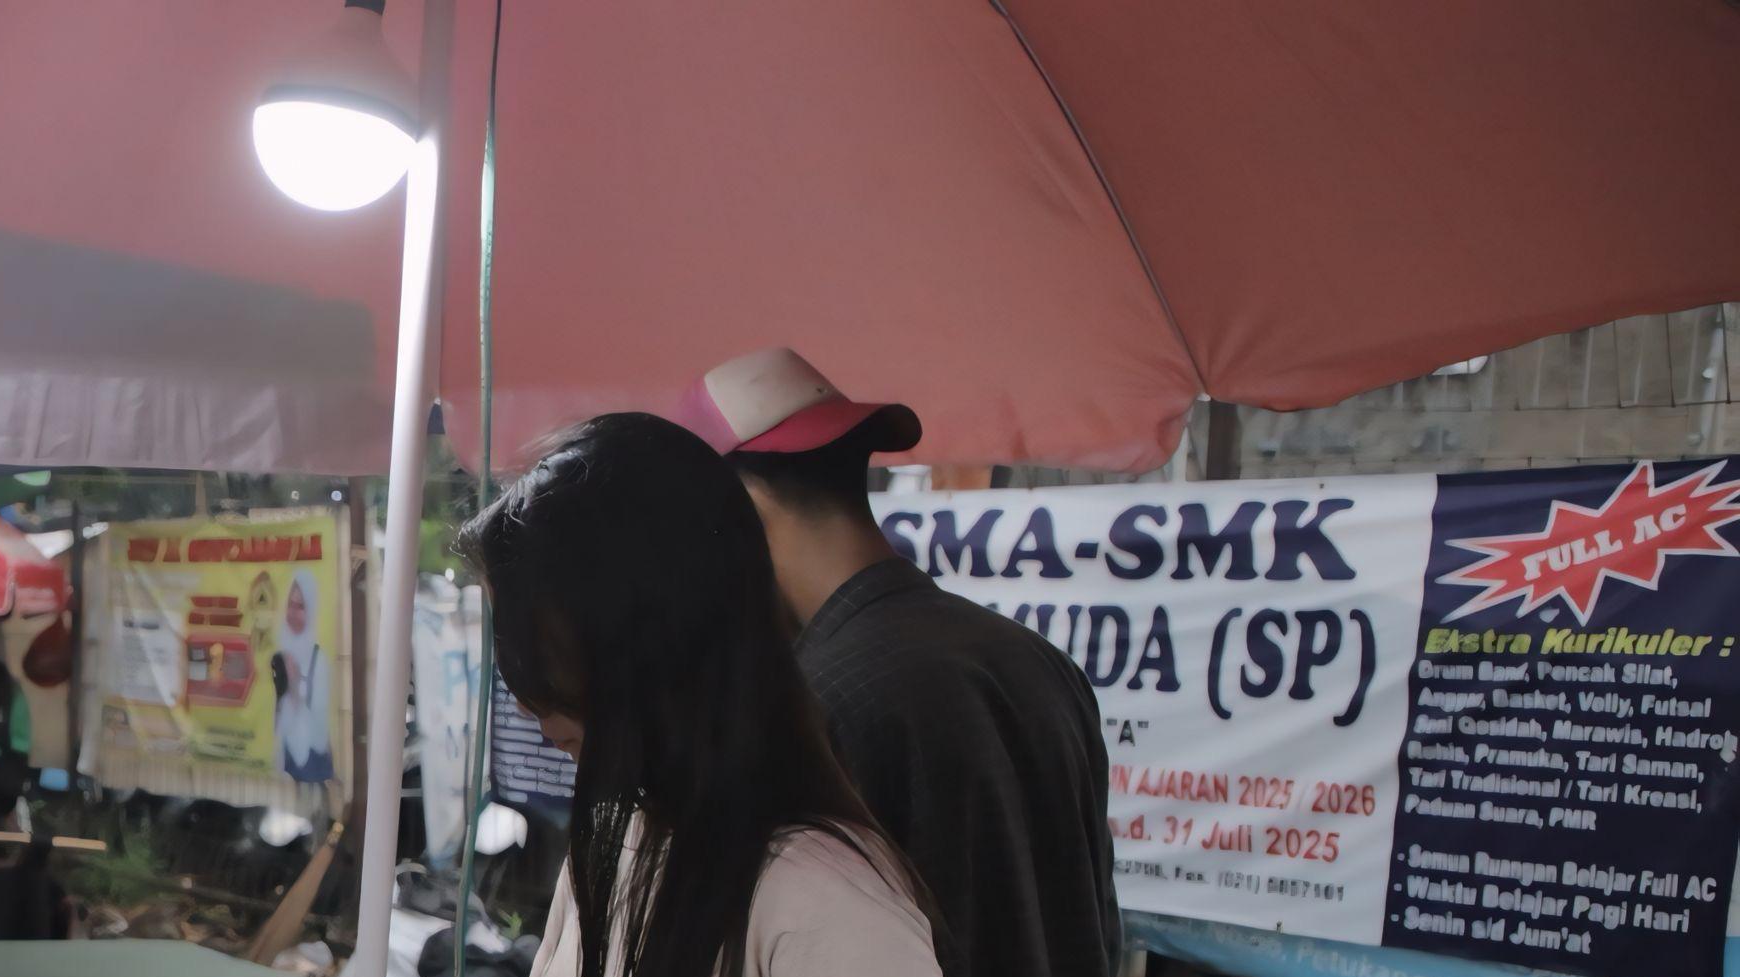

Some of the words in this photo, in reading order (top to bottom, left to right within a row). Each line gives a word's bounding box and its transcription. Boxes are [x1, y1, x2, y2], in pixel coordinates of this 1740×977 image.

[879, 499, 1356, 580] SMA-SMK
[1522, 530, 1623, 581] FULL
[1633, 504, 1687, 544] AC
[1424, 628, 1531, 655] Ekstra
[1540, 627, 1712, 657] Kurikuler
[1208, 608, 1376, 726] (SP)
[1417, 659, 1473, 680] Drum
[1537, 661, 1616, 683] Pencak
[1641, 694, 1711, 717] Futsal
[1575, 750, 1617, 772] Tari
[1622, 753, 1704, 783] Saman,
[1136, 767, 1228, 803] AJARAN
[1239, 775, 1294, 809] 2025
[1311, 781, 1376, 816] 2026
[1577, 780, 1618, 803] Tari
[1163, 815, 1194, 845] 31
[1201, 822, 1252, 853] Juli
[1265, 827, 1340, 863] 2025
[1548, 807, 1597, 831] PMR
[1474, 851, 1558, 887] Ruangan
[1562, 861, 1636, 896] Belajar
[1639, 870, 1678, 898] Full
[1684, 875, 1717, 902] AC
[1407, 875, 1477, 906] Waktu
[1482, 884, 1568, 920] Belajar
[1572, 895, 1628, 930] Pagi
[1633, 903, 1690, 933] Hari
[1403, 905, 1465, 937] Senin
[1509, 920, 1591, 955] Jum'at
